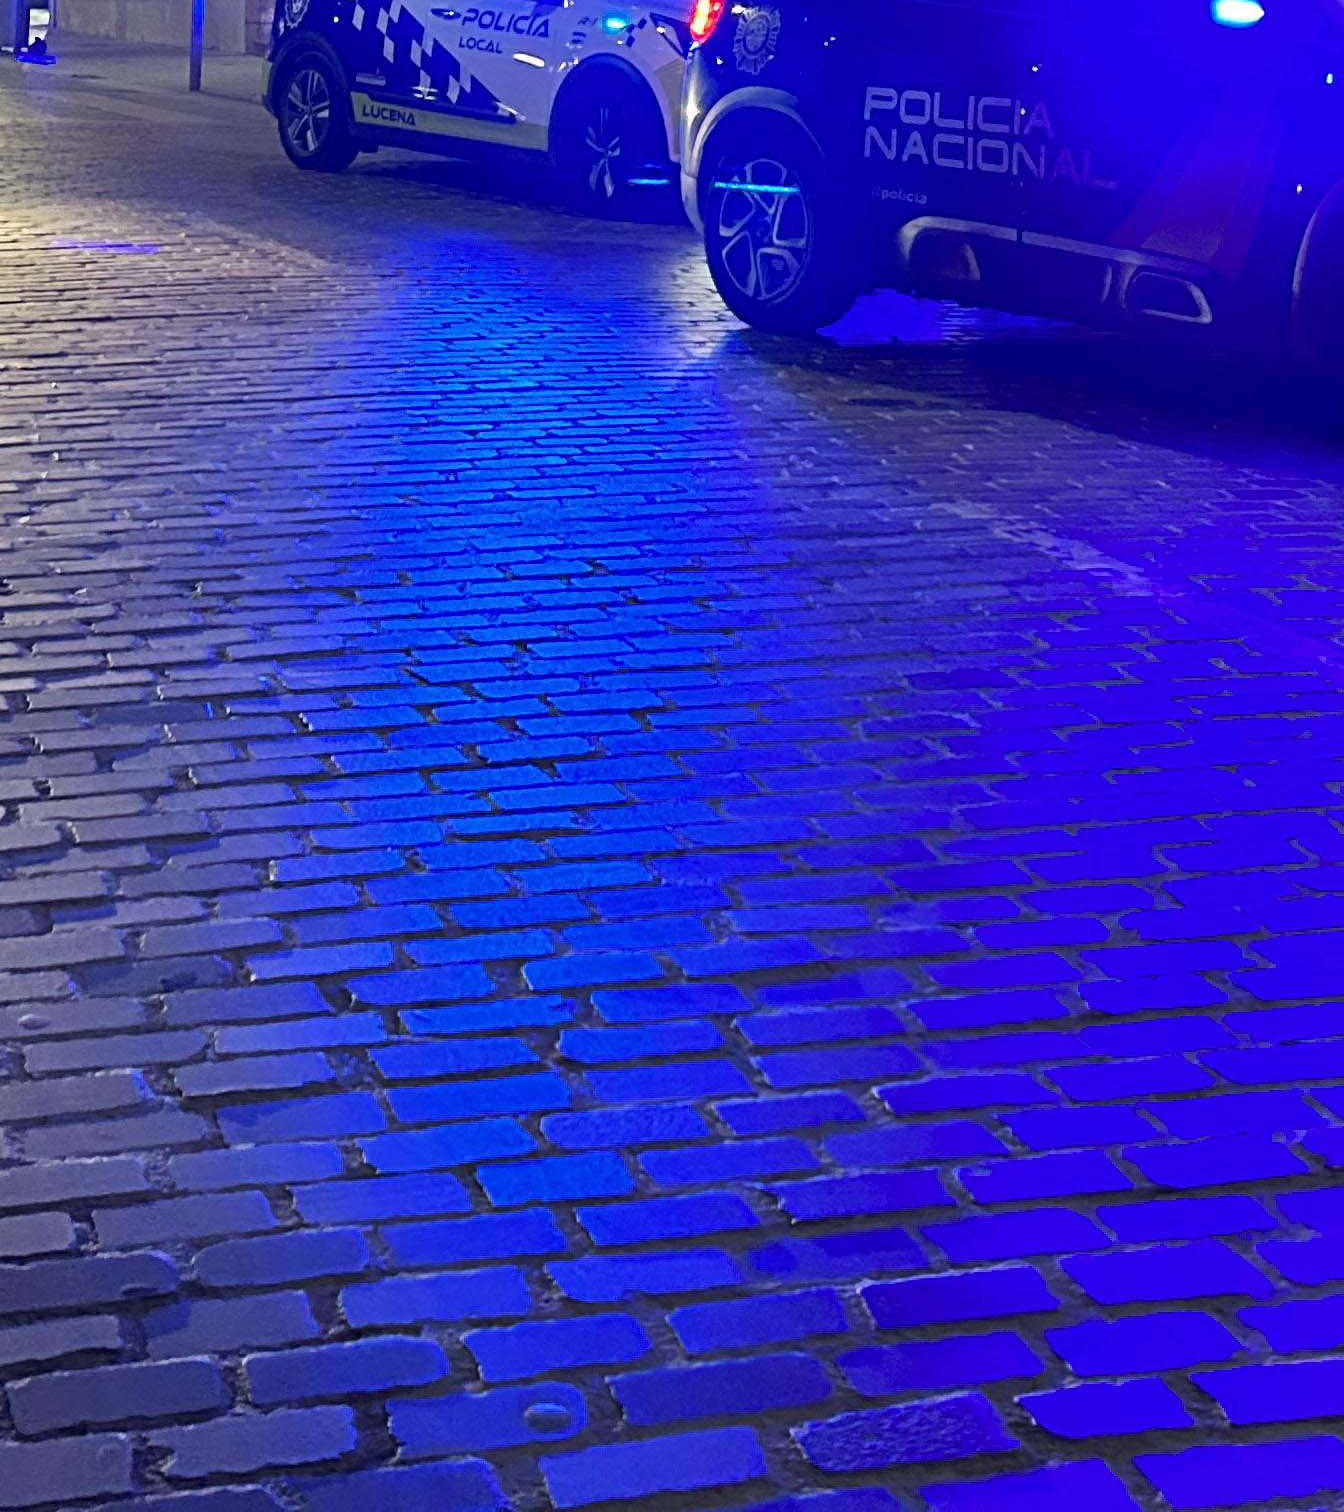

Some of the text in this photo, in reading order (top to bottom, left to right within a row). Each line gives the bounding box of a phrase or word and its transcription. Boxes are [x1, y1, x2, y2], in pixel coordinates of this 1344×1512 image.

[458, 36, 503, 54] LOCAL
[362, 104, 416, 126] LUCENA
[863, 86, 1055, 138] POLICIA
[863, 126, 1120, 190] NACIONAL
